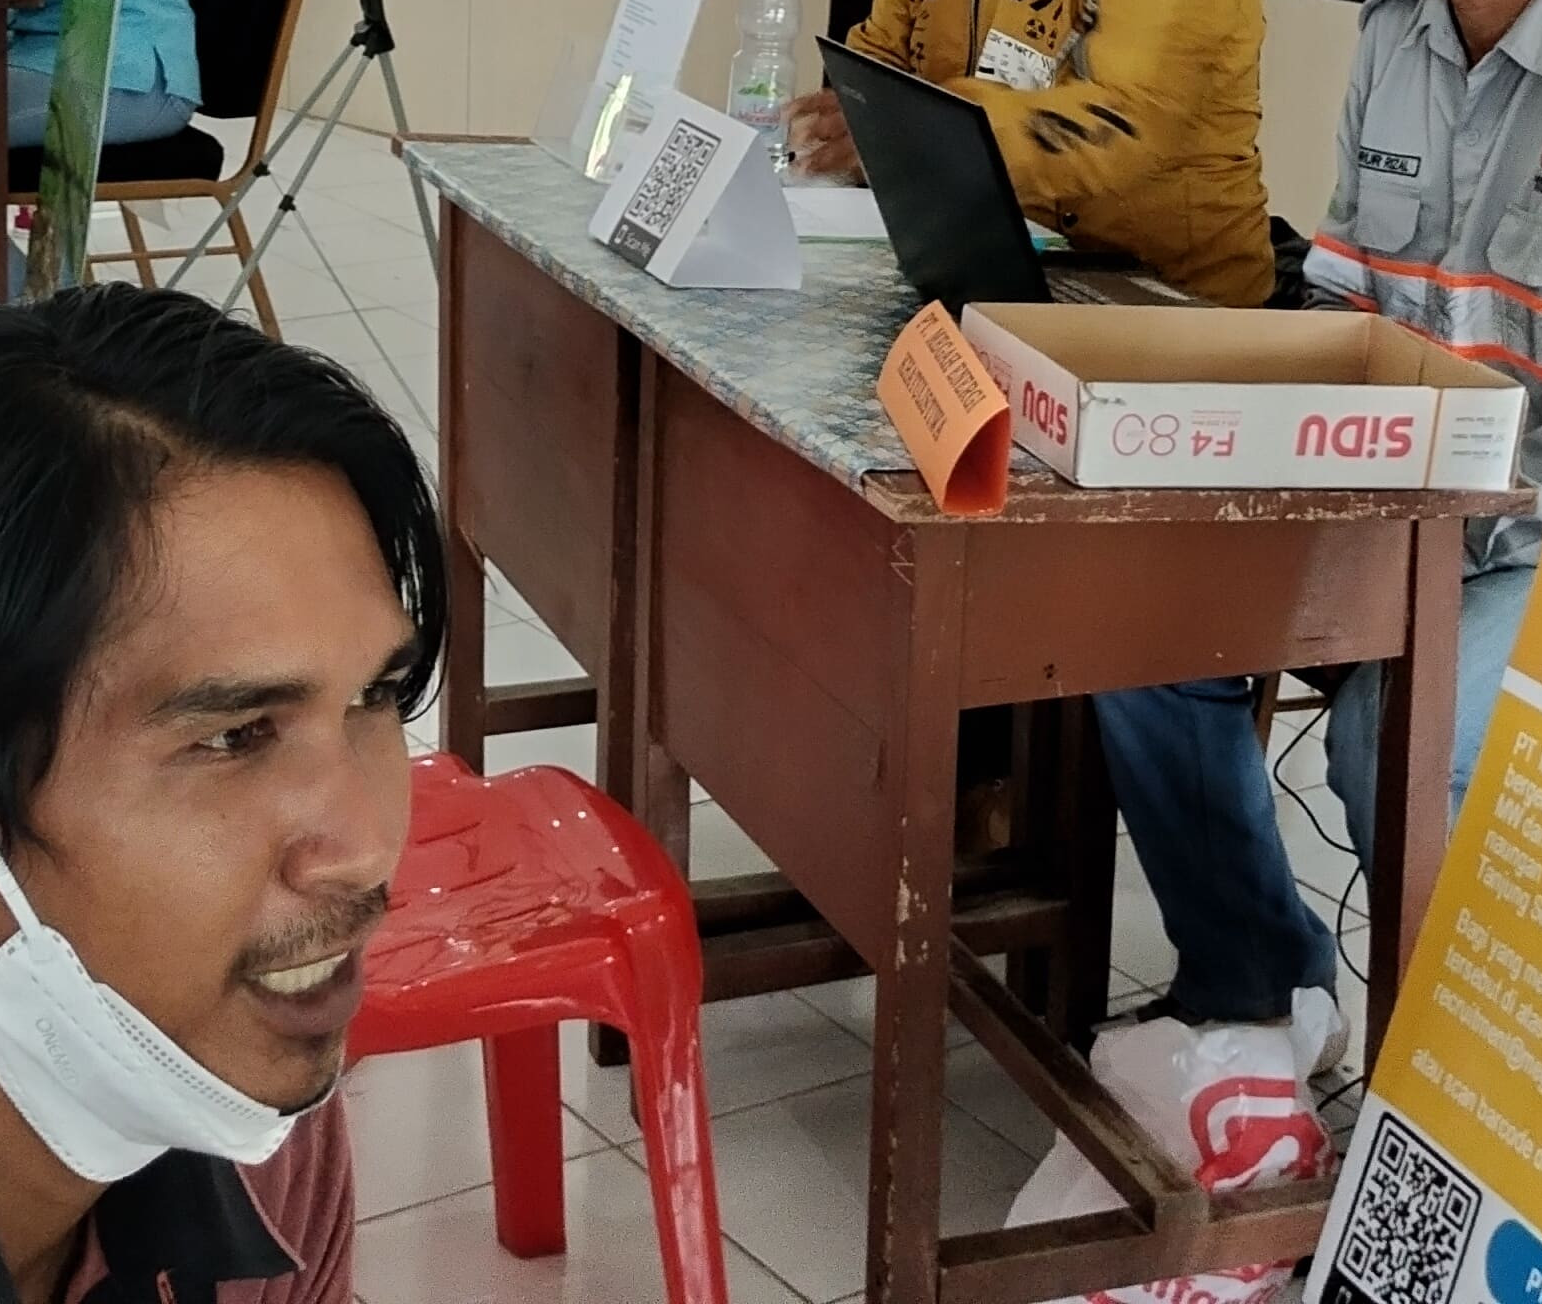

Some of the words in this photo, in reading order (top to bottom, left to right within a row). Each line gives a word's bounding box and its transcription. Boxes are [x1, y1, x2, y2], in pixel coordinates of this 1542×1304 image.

[925, 327, 960, 374] MEGAH
[946, 361, 987, 414] ENERGI
[1191, 429, 1235, 457] F4
[1513, 731, 1538, 762] PT
